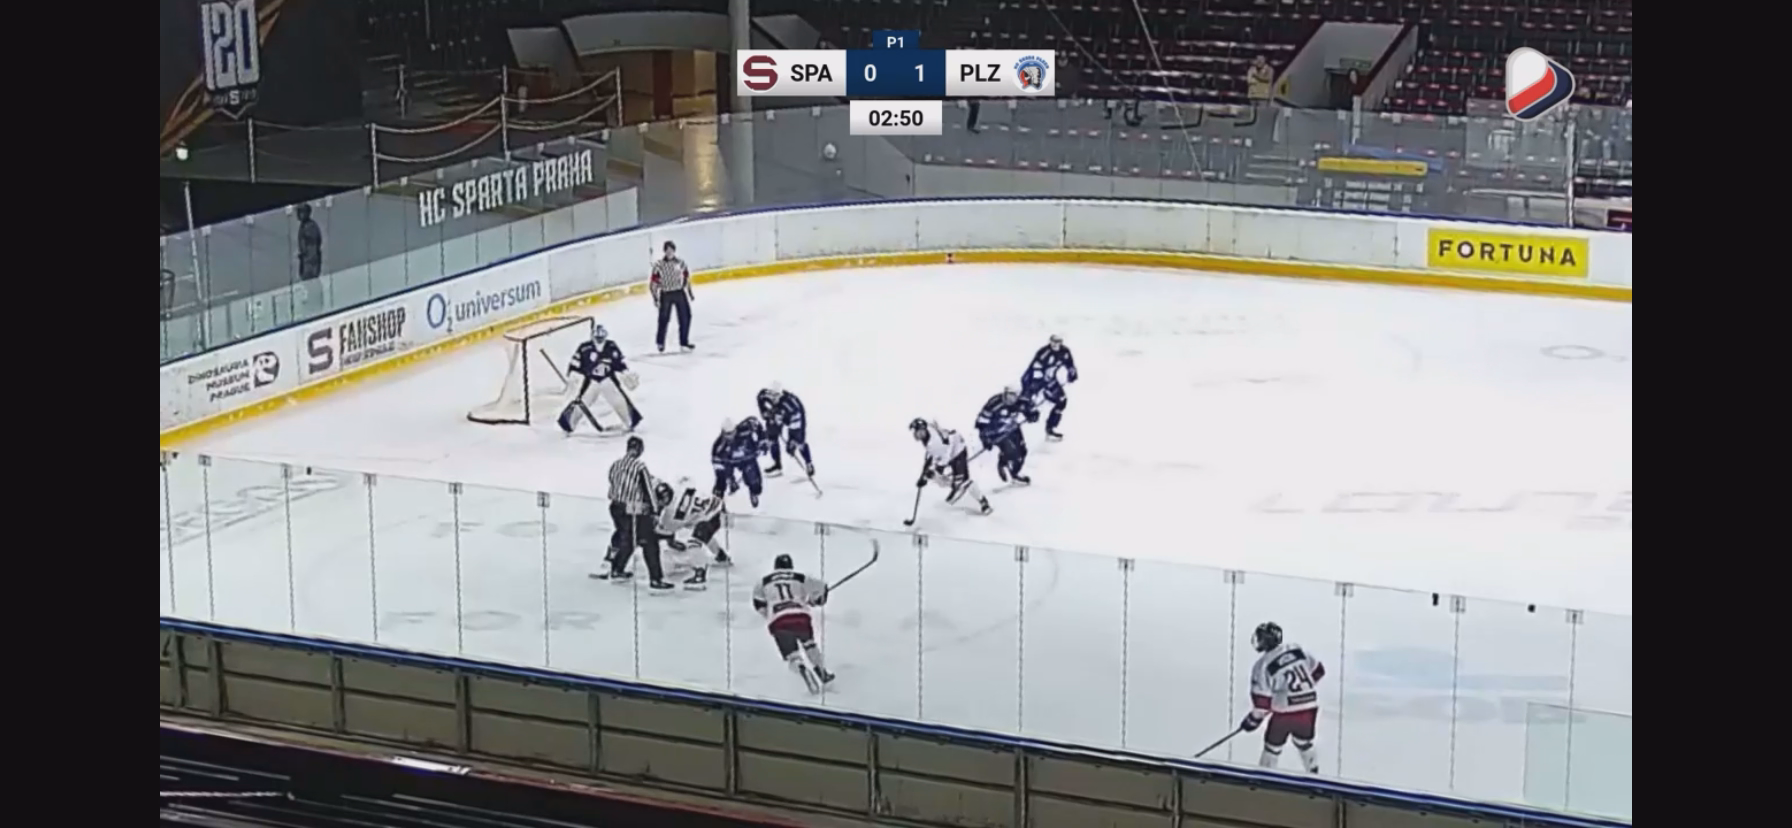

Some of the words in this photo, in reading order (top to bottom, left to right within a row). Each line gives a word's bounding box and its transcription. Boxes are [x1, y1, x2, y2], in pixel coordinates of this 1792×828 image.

[201, 0, 260, 91] 120
[419, 188, 446, 227] HC
[452, 165, 528, 219] SPARTA
[533, 149, 593, 197] PRAHA
[1438, 239, 1578, 267] FORTUNA
[455, 279, 542, 322] universum
[339, 307, 406, 354] FANSHOP
[209, 382, 251, 403] PRAGUE
[773, 582, 795, 601] 11
[1284, 662, 1314, 693] 24
